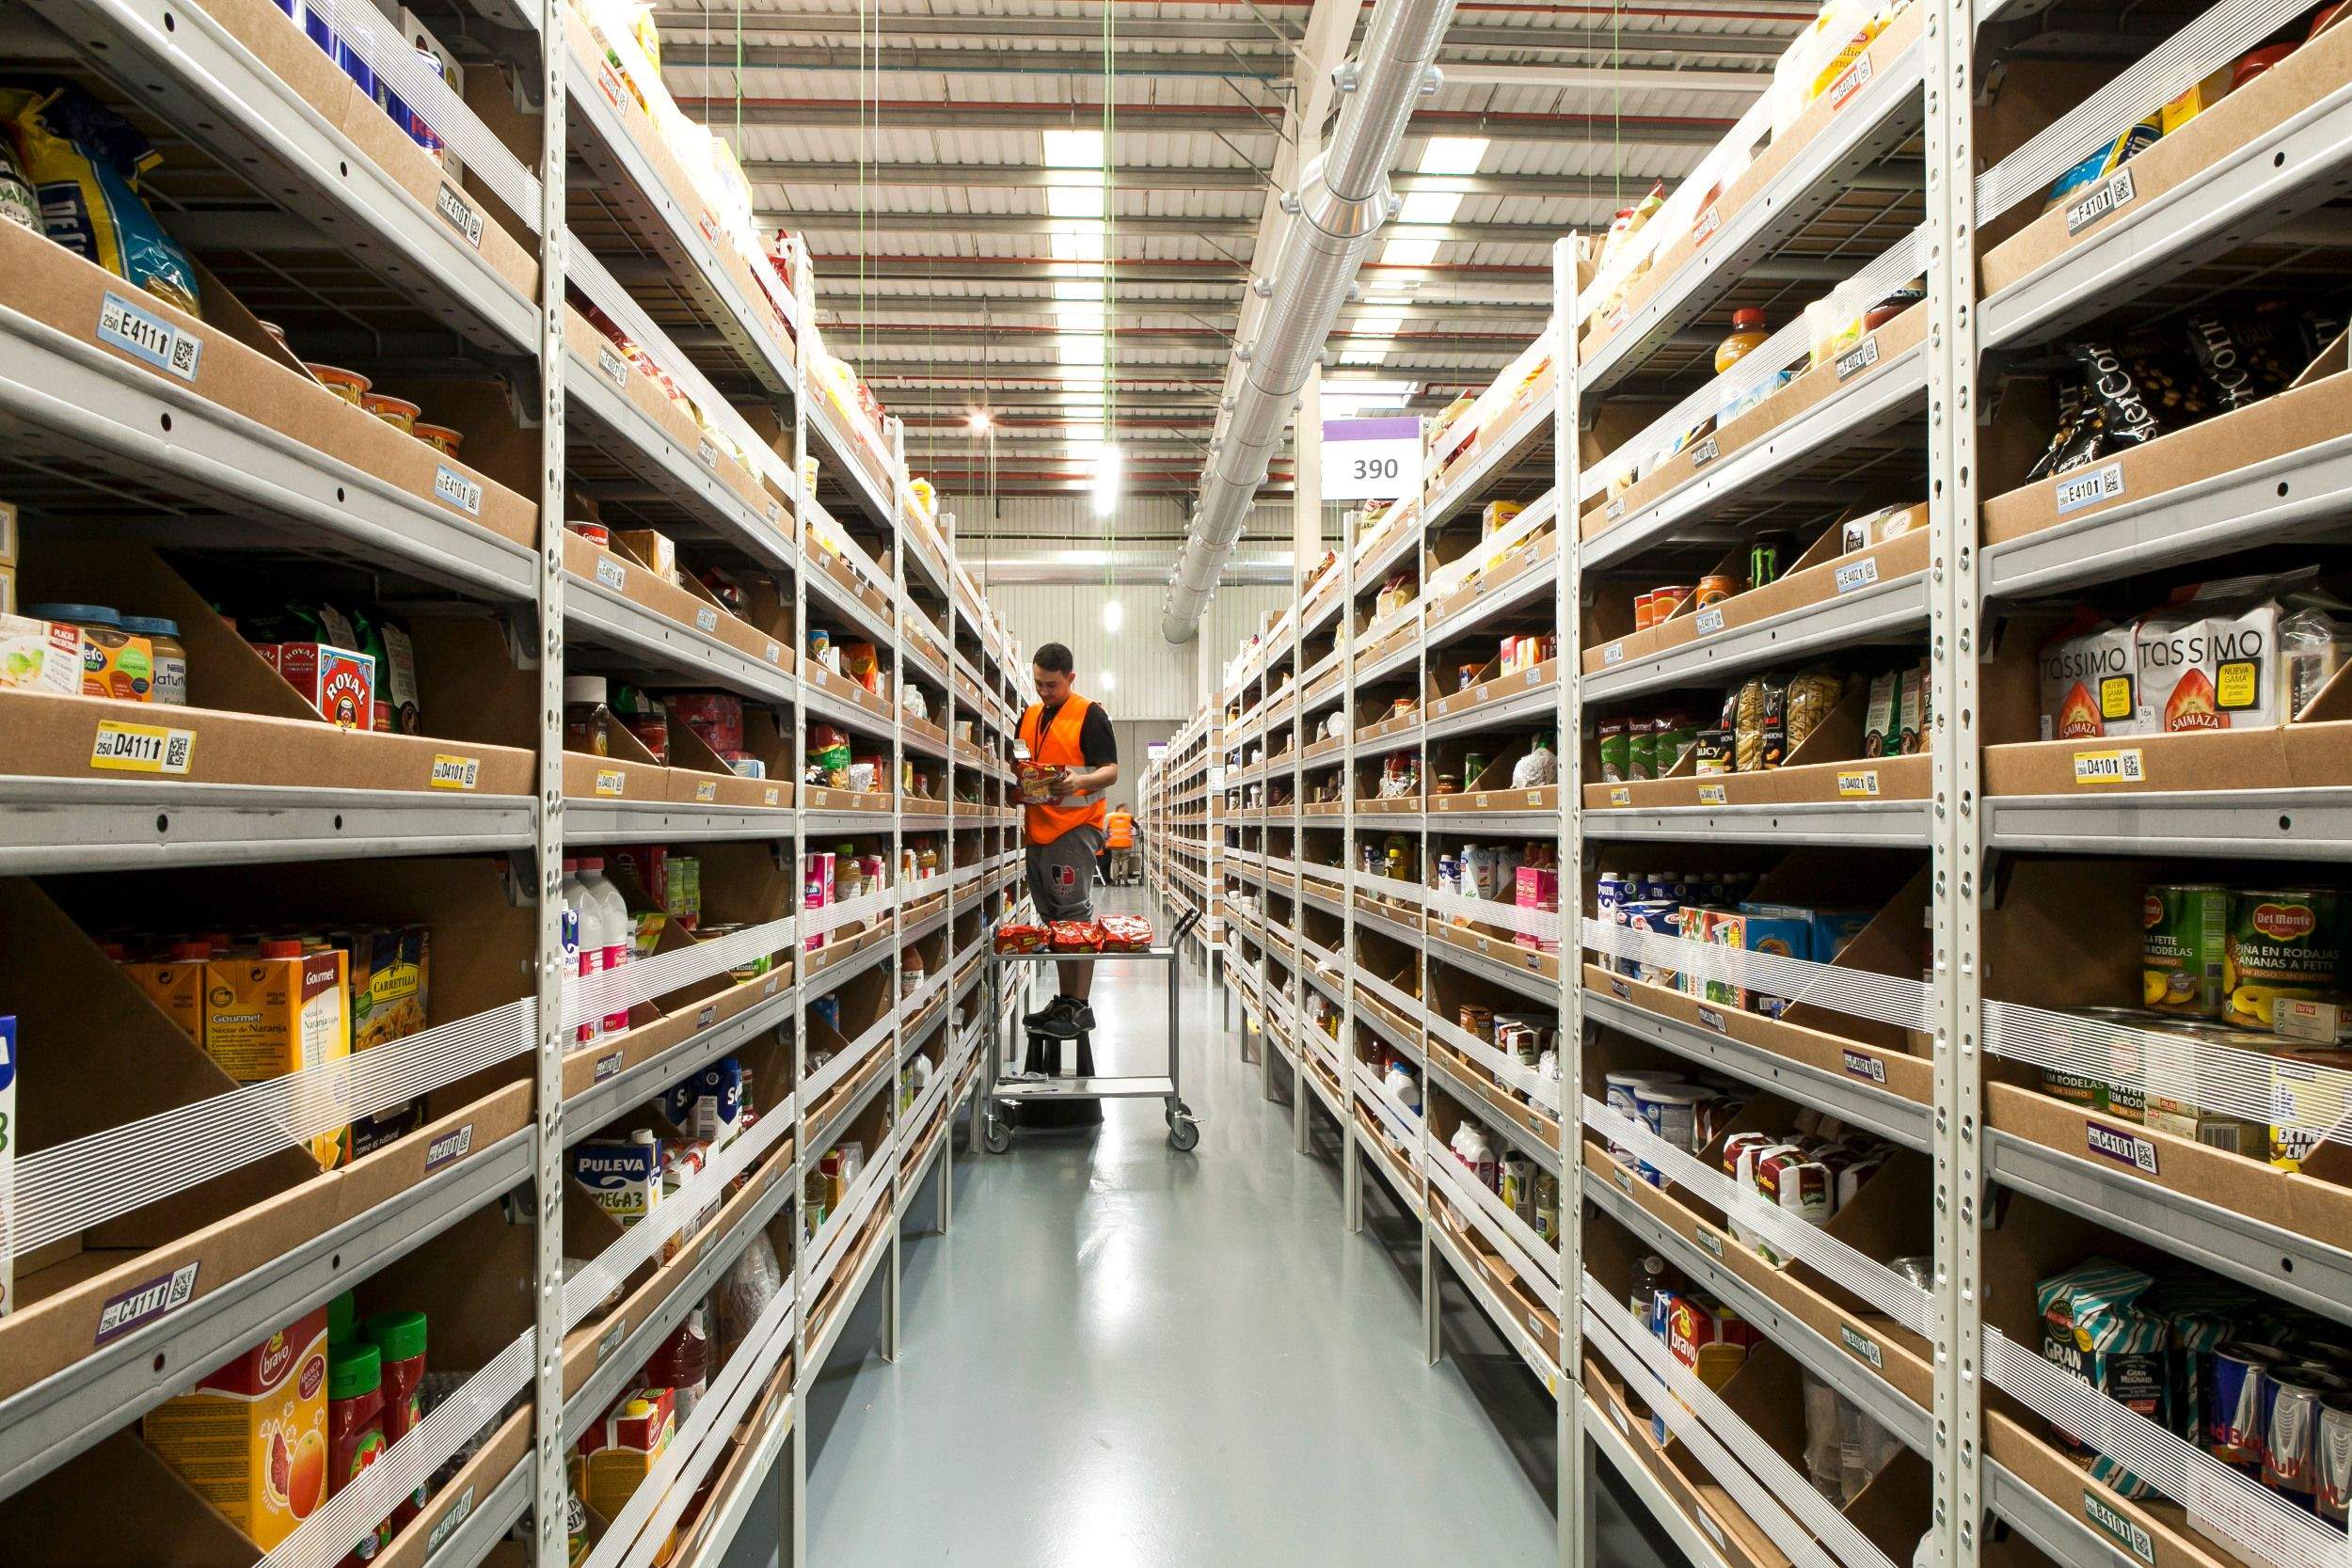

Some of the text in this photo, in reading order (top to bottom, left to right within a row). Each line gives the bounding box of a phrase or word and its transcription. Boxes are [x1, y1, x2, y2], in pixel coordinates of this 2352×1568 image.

[448, 196, 465, 227] F410
[2078, 195, 2103, 221] F410
[103, 312, 156, 349] 250 E411
[1843, 353, 1859, 372] F402
[1353, 458, 1399, 480] 390
[444, 476, 461, 499] E410
[2068, 481, 2093, 503] E410
[583, 532, 607, 545] Gourmet
[1843, 568, 1859, 584] E402
[54, 628, 75, 641] PLACAS
[84, 649, 103, 661] ero
[285, 646, 318, 660] ROYAL
[2224, 666, 2249, 675] NUEVA
[2105, 681, 2124, 689] NUEVA
[2224, 674, 2248, 684] GAMA
[326, 673, 367, 705] ROYAL
[2106, 689, 2123, 698] GAMA
[2062, 722, 2097, 738] SAIMAZA
[2171, 714, 2219, 732] SAIMAZA
[96, 742, 112, 755] 250
[114, 734, 151, 759] D411
[1696, 746, 1721, 758] aucy
[442, 762, 460, 780] D410
[2087, 759, 2112, 775] D410
[1845, 777, 1861, 789] D402
[2257, 912, 2311, 927] Del Monte
[2154, 936, 2178, 945] FETTE
[2151, 946, 2193, 957] RODELAS
[2235, 942, 2340, 959] PIÑA EN RODAJAS
[2238, 957, 2334, 971] ANANAS A FETTE
[306, 970, 334, 985] Gourmet
[2253, 970, 2278, 978] JUGO
[373, 974, 416, 993] CARRETILLA
[213, 1013, 262, 1023] Gourmet
[248, 1023, 287, 1035] Naranja
[1851, 1054, 1867, 1072] C402
[2057, 1075, 2105, 1089] RODELAS
[2065, 1088, 2088, 1098] SUMO
[2127, 1087, 2144, 1098] FET
[2112, 1095, 2145, 1108] EM ROD
[2118, 1106, 2128, 1116] EM
[436, 1136, 453, 1159] C410
[2099, 1132, 2125, 1155] C410
[579, 1158, 645, 1173] PULEVA
[595, 1191, 644, 1208] MEGA 3
[119, 1291, 155, 1323] C411
[1671, 1326, 1696, 1362] bravo
[1849, 1330, 1865, 1352] B402
[263, 1345, 289, 1374] bravo
[2043, 1337, 2081, 1370] GRAN
[2121, 1375, 2152, 1384] MUGNAIO
[2096, 1503, 2122, 1534] B410
